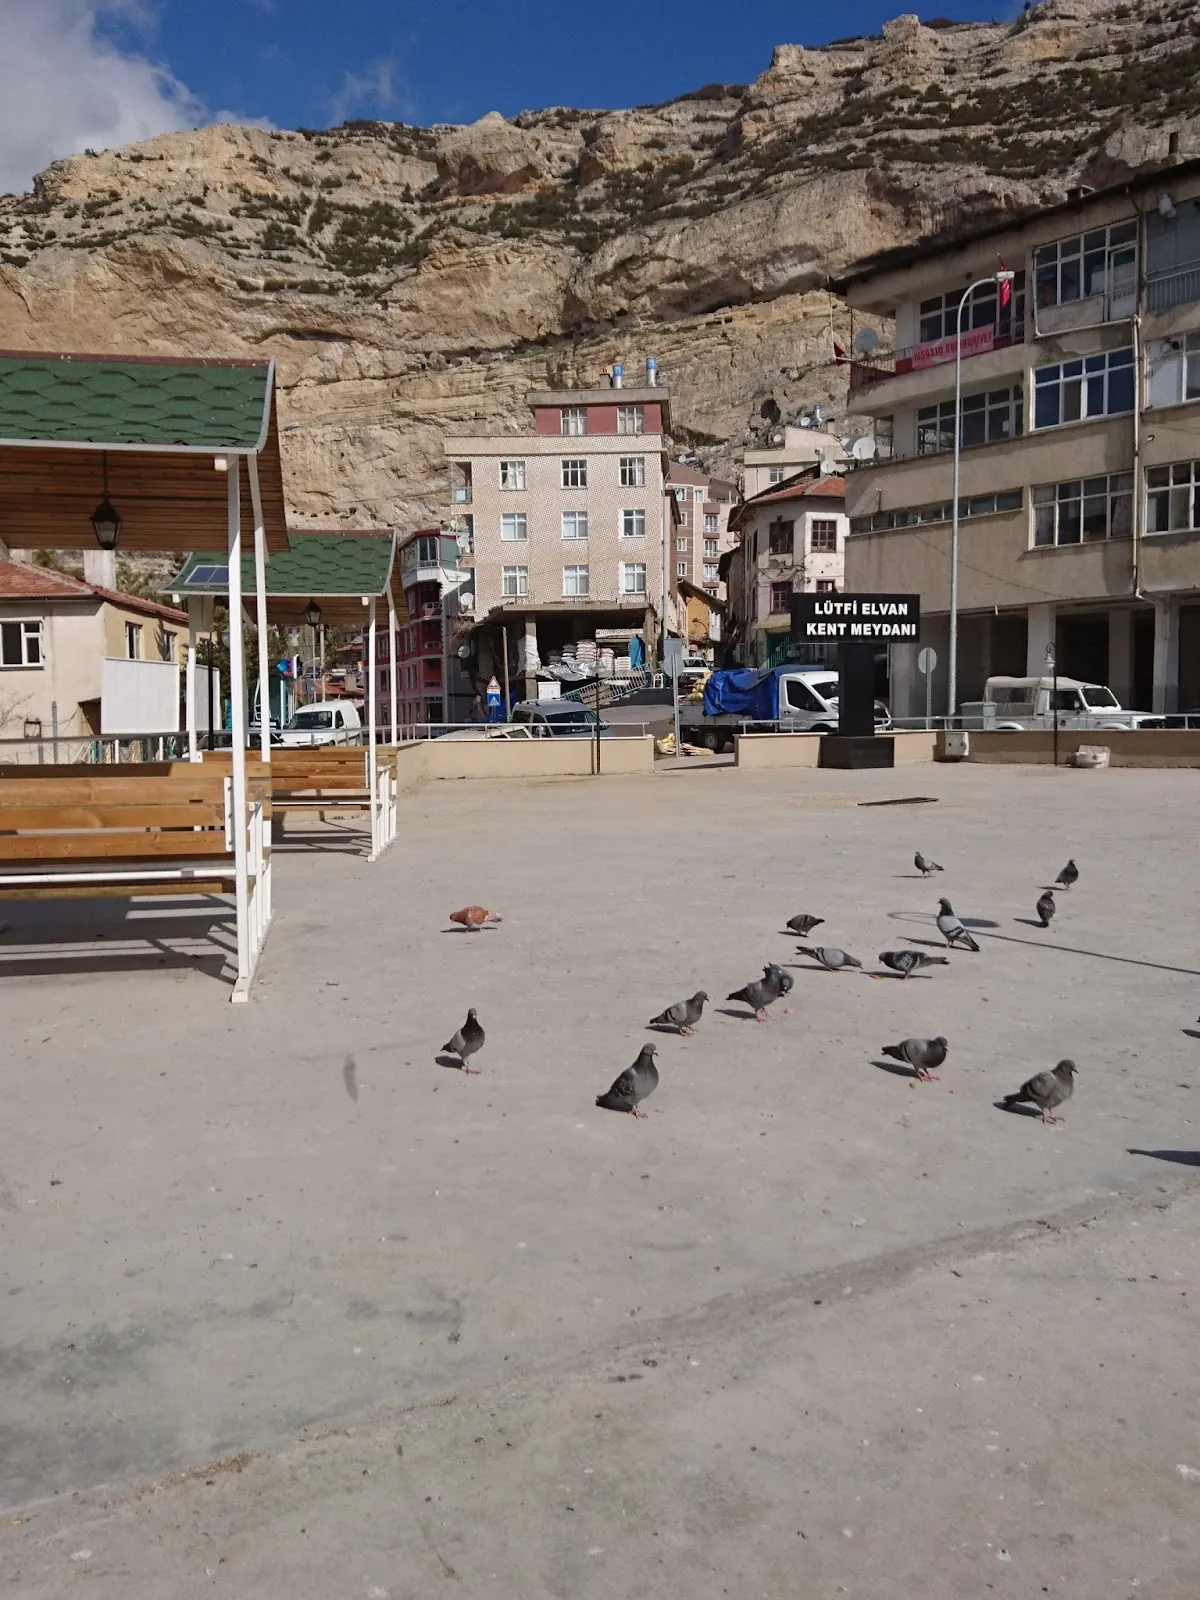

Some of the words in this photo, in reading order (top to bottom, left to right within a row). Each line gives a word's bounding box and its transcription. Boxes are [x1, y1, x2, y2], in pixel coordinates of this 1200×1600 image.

[815, 600, 857, 615] LÜTFİ
[861, 603, 908, 615] ELVAN
[806, 623, 846, 636] KENT
[851, 624, 916, 636] MEYDANI
